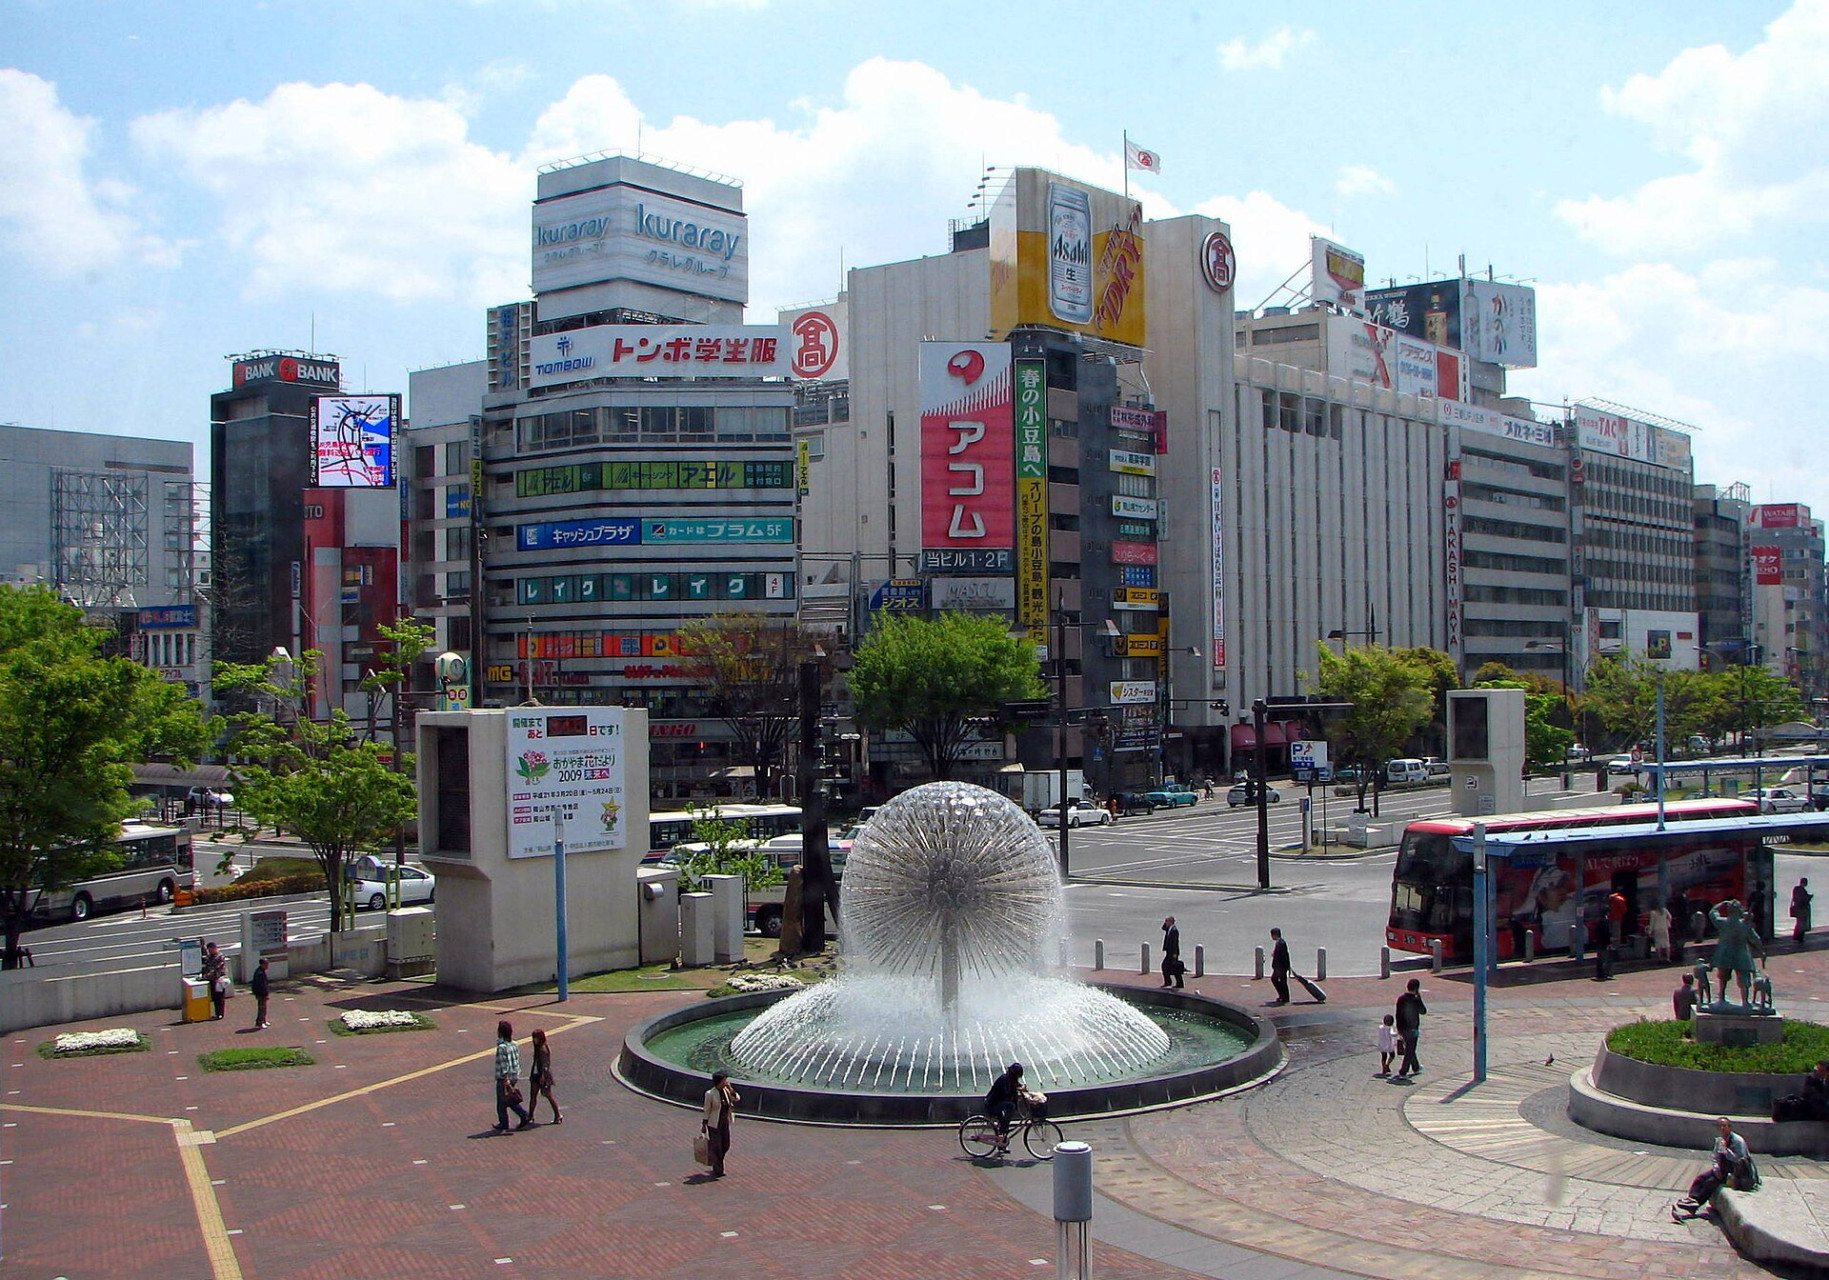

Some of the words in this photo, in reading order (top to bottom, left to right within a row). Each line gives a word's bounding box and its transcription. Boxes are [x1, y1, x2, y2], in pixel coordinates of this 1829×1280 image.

[538, 217, 609, 246] kuraray
[636, 203, 739, 261] kuraray
[1054, 233, 1088, 266] Asahi
[649, 249, 731, 280] クラレグループ
[1066, 267, 1077, 282] 生
[612, 337, 778, 363] トンボ学生服
[245, 362, 275, 380] BANK
[297, 364, 337, 382] BANK
[535, 356, 593, 376] TOMBOW
[1021, 369, 1041, 476] 春の小豆島へ
[1599, 417, 1617, 438] TAC
[681, 466, 736, 483] アエル
[948, 420, 986, 538] アコム
[553, 525, 635, 544] キャッシュプラザ
[526, 577, 594, 599] レイク
[653, 578, 745, 595] レイク
[1448, 514, 1458, 645] TAKASHIMAYA
[882, 597, 920, 609] ジオス
[487, 665, 512, 682] MG
[527, 729, 543, 739] あと
[553, 754, 616, 770] おかやま花だより
[558, 769, 582, 783] 2009
